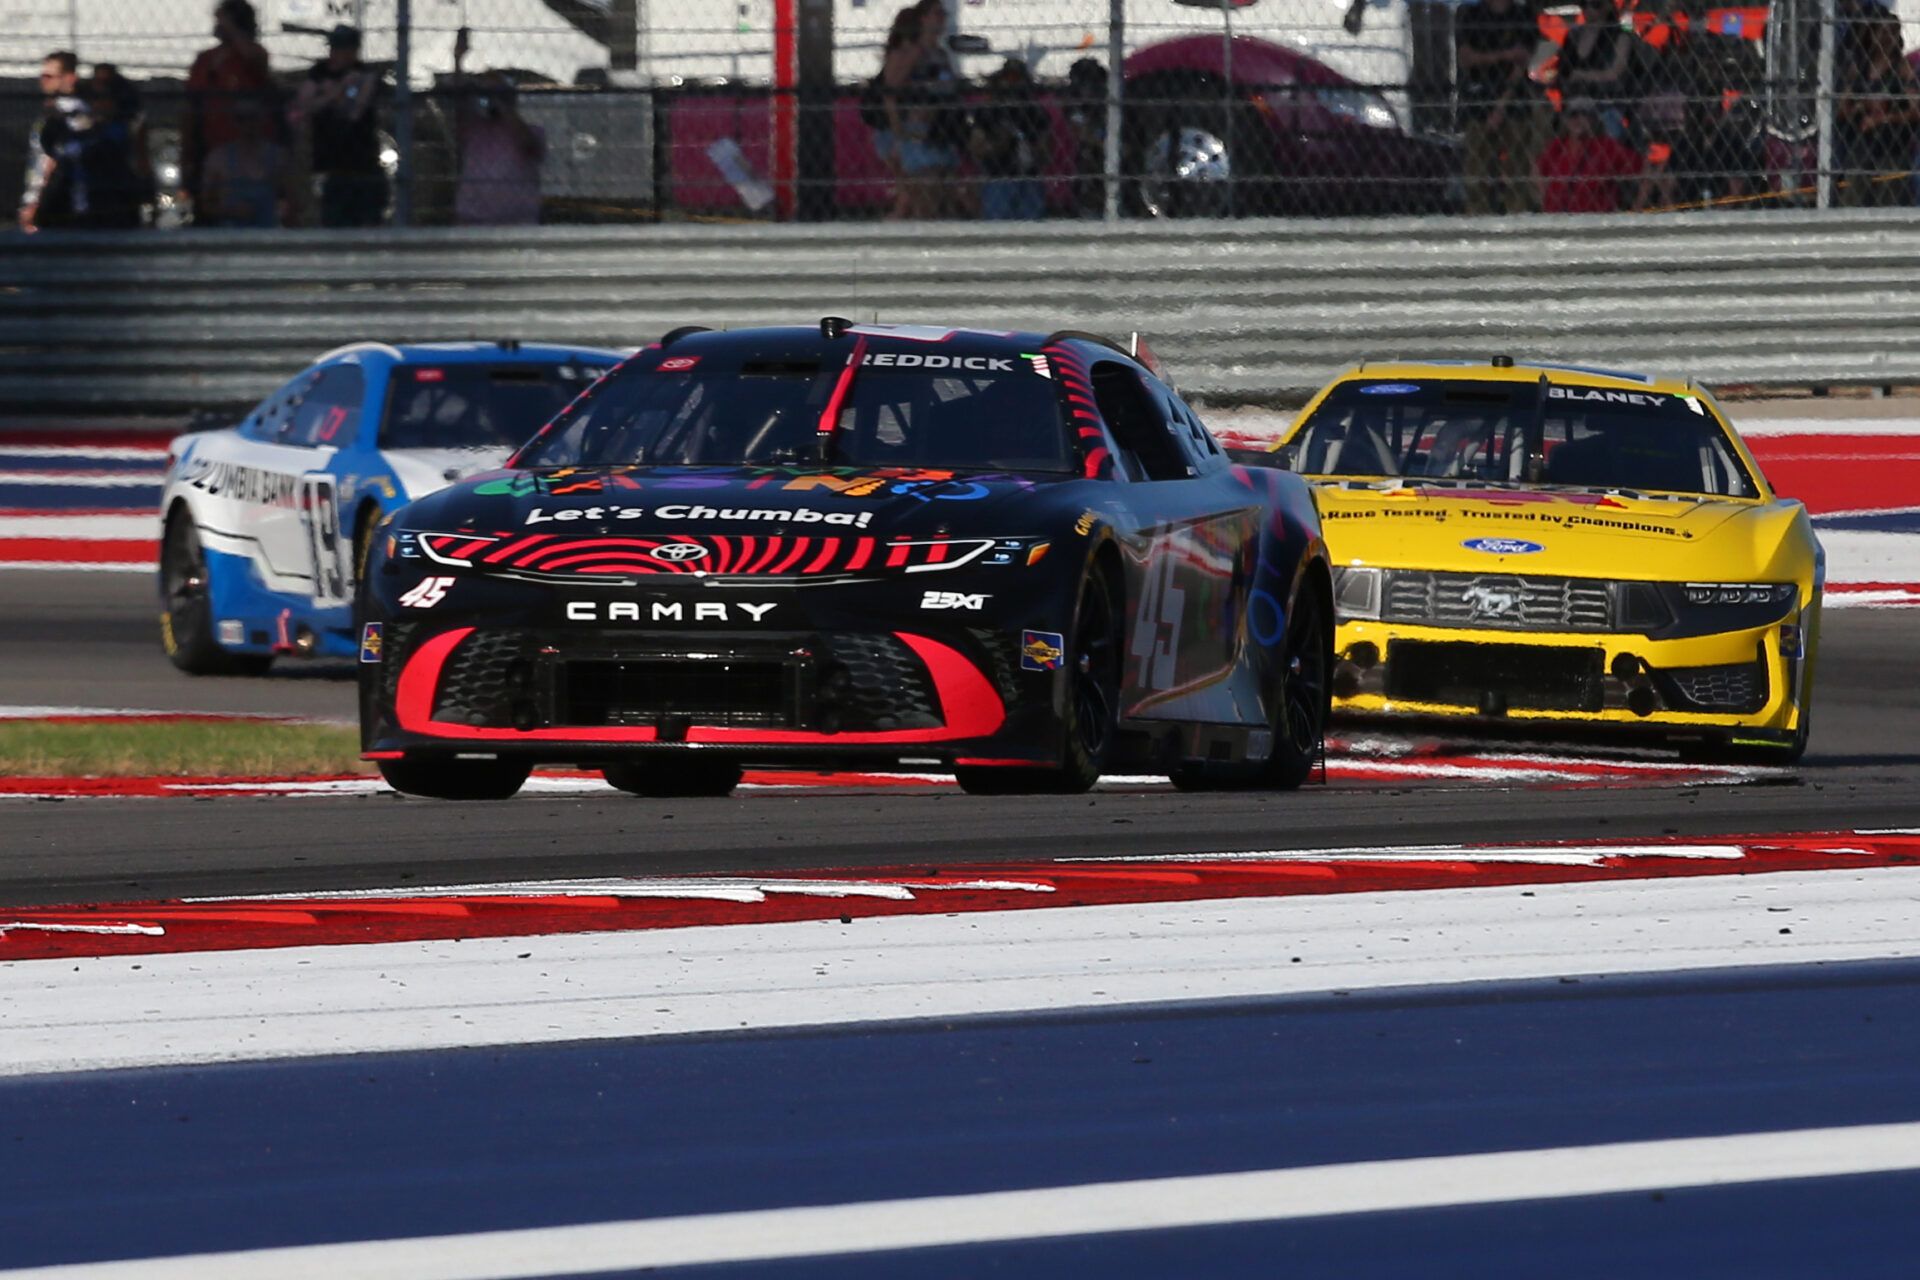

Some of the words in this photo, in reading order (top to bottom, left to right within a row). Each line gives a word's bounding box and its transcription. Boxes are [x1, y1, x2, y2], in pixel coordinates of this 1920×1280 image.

[1548, 387, 1666, 407] BLANEY
[525, 505, 643, 525] Let's
[654, 504, 873, 529] Chumba!
[1459, 509, 1535, 521] Trusted
[1540, 513, 1563, 523] by
[399, 577, 456, 608] 45
[566, 601, 778, 622] CAMRY
